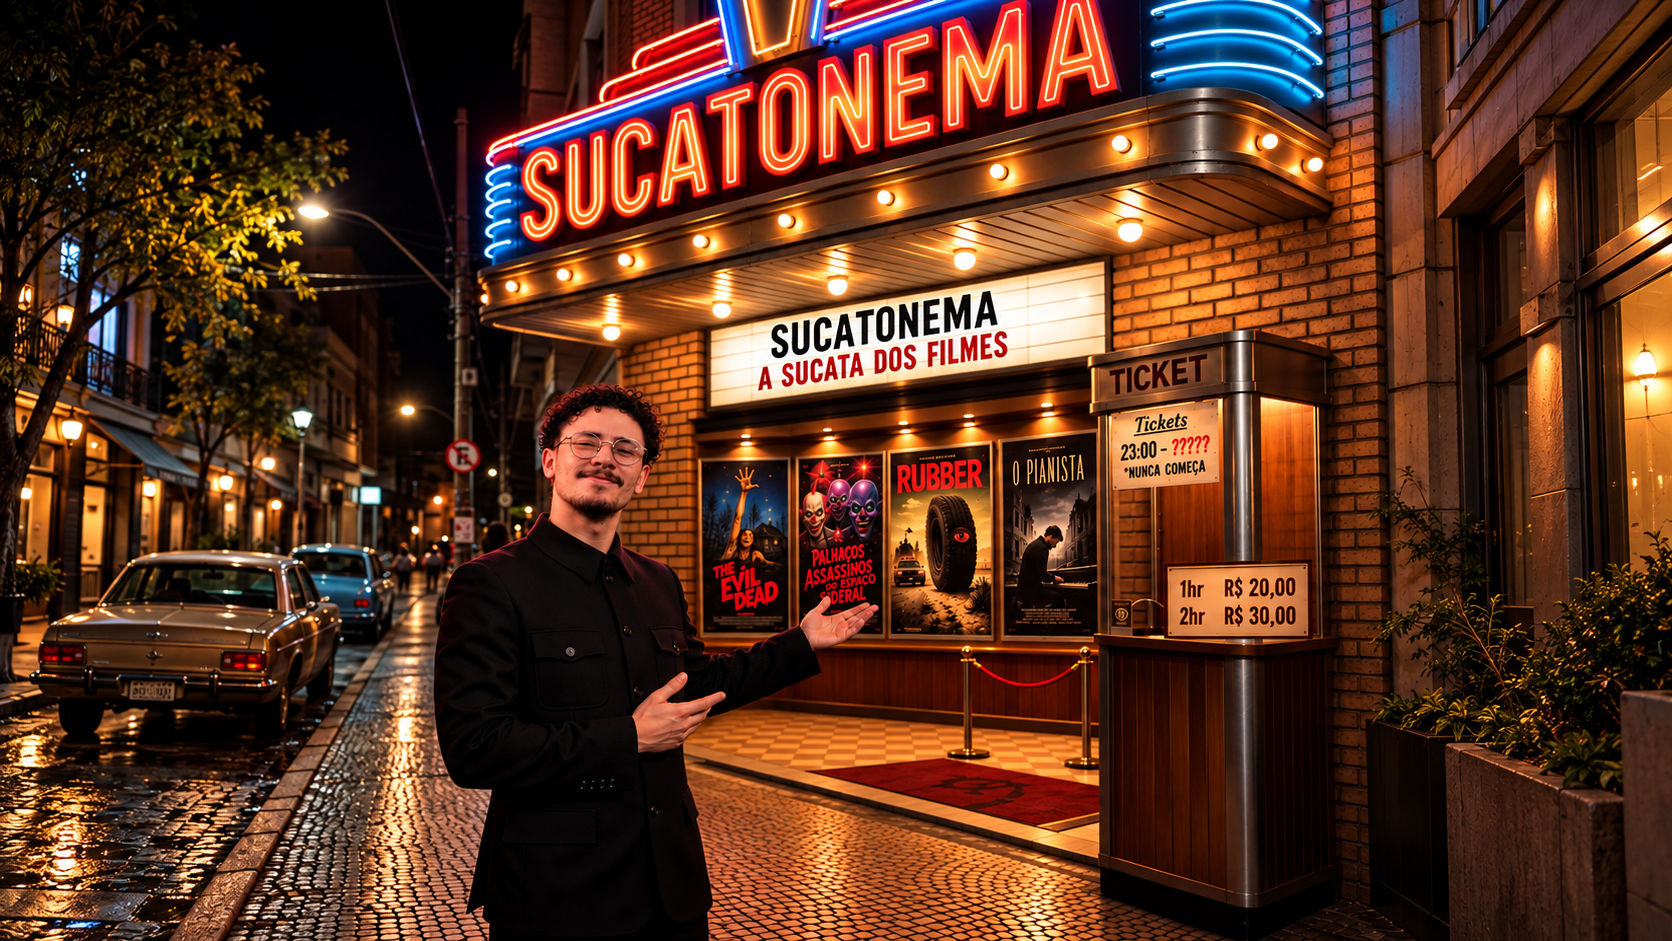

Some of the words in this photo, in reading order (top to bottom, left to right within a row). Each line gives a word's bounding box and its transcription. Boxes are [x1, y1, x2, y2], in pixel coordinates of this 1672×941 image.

[520, 0, 1122, 243] SUCATONEMA
[771, 290, 998, 358] SUCATONEMA
[757, 366, 773, 391] A
[781, 352, 864, 388] SUCATA
[874, 344, 917, 375] DOS
[927, 331, 1008, 368] FILMES
[1109, 353, 1208, 395] TICKET
[1135, 413, 1188, 434] Tickets
[1120, 441, 1157, 461] 23:00
[1171, 434, 1210, 456] ?????
[897, 458, 983, 494] RUBBER
[1012, 460, 1020, 486] O
[1026, 454, 1085, 485] PIANISTA
[1165, 460, 1206, 476] COMEÇA
[713, 561, 735, 579] THE
[804, 559, 873, 592] ASSASSINOS
[734, 580, 779, 611] DEAD
[826, 582, 838, 591] DO
[1180, 579, 1204, 598] 1hr
[1224, 577, 1243, 599] R$
[1249, 577, 1296, 599] 20,00
[1179, 607, 1205, 626] 2hr
[1224, 605, 1243, 627] R$
[1249, 605, 1296, 628] 30,00
